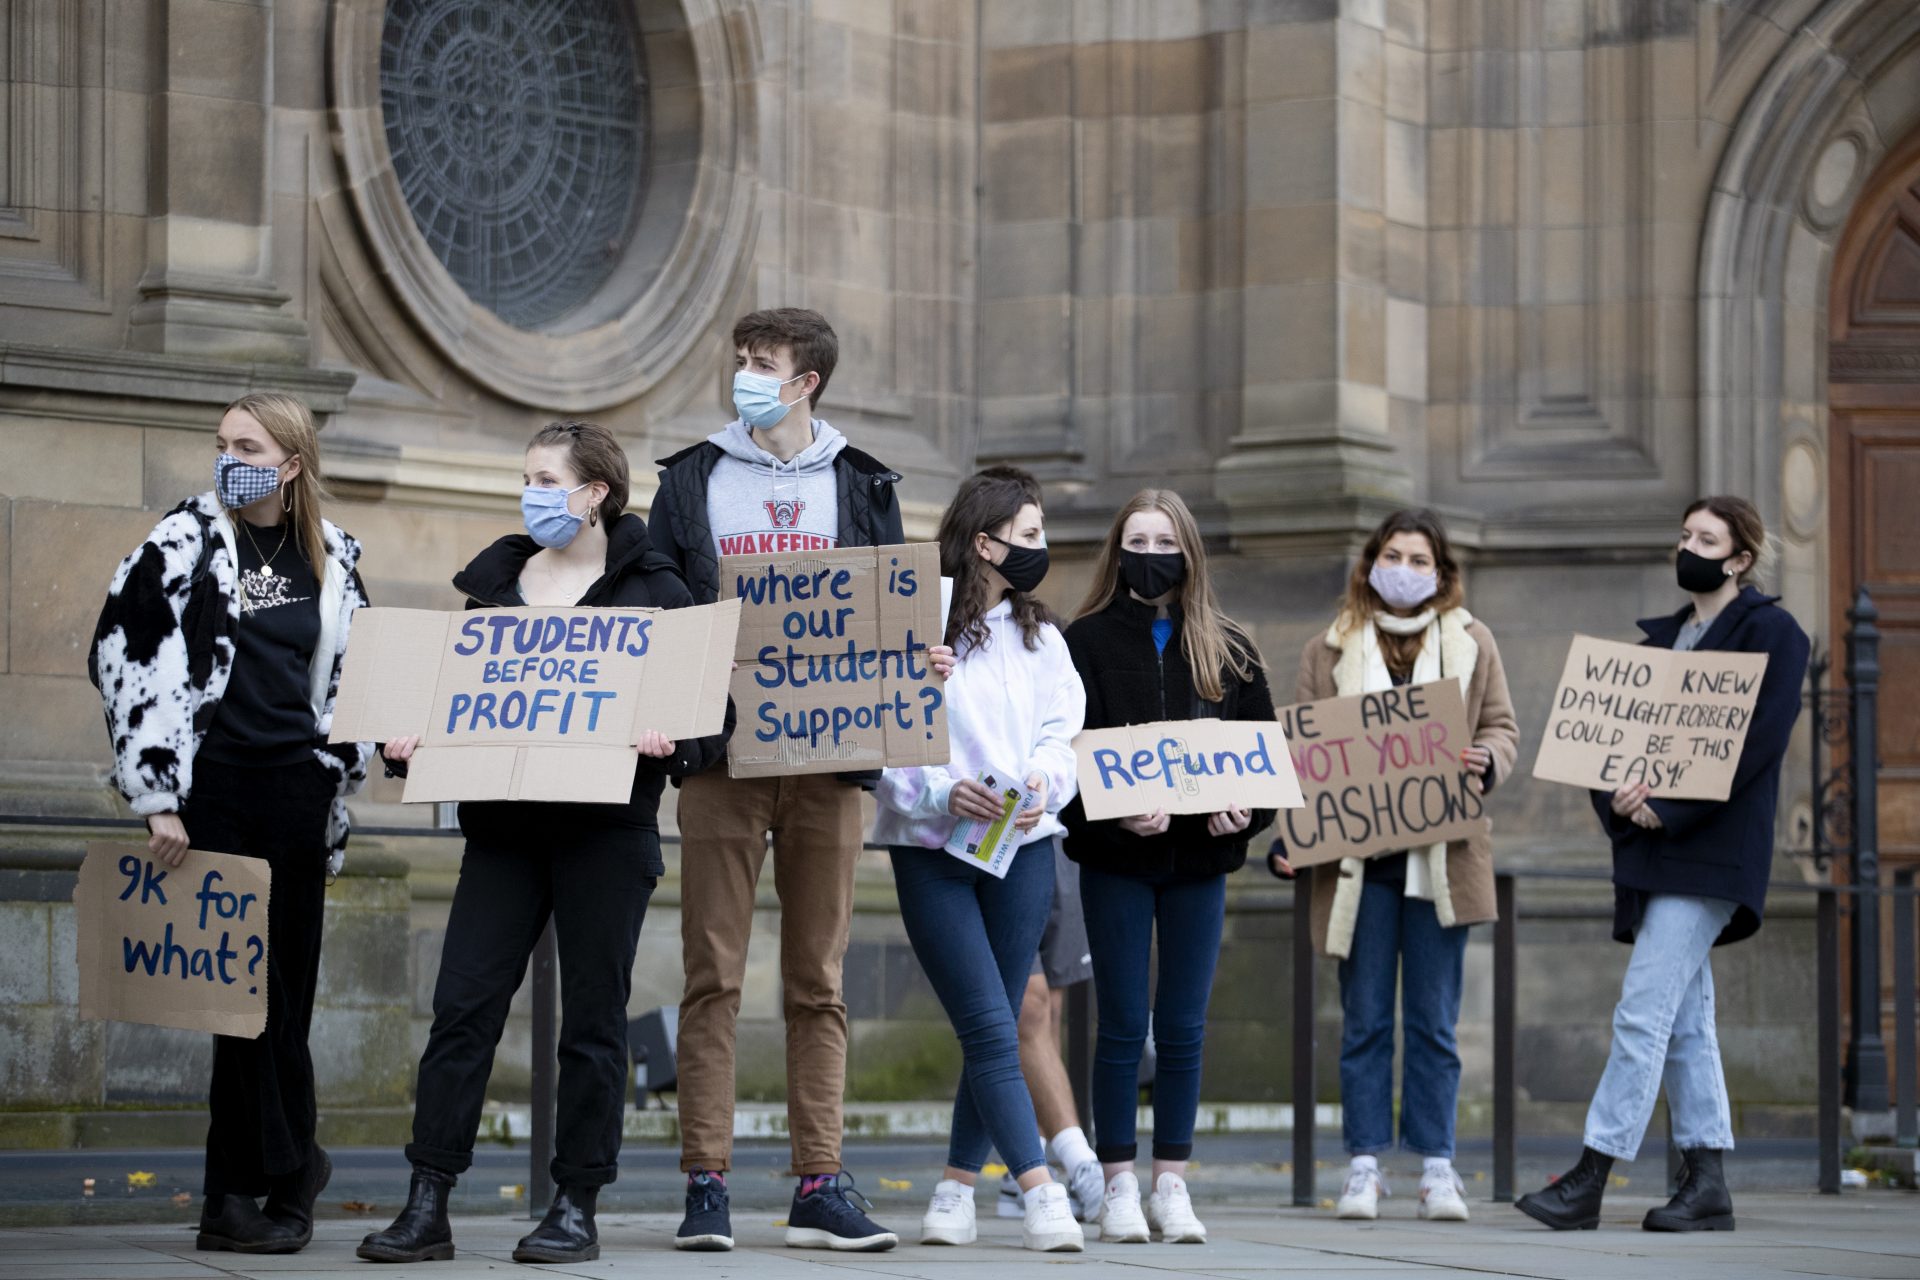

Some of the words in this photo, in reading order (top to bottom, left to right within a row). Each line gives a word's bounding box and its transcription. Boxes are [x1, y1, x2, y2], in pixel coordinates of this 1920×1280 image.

[737, 564, 853, 605] where
[889, 557, 918, 597] is
[454, 615, 653, 657] STUDENTS
[783, 607, 855, 640] our
[482, 657, 599, 684] BEFORE
[1585, 653, 1652, 688] WHO
[1681, 669, 1758, 695] KNEW
[446, 689, 618, 735] PROFIT
[1360, 687, 1429, 729] ARE
[1093, 731, 1277, 790] Refund
[1366, 721, 1458, 776] YOUR
[1555, 720, 1625, 746] COULD
[1646, 734, 1674, 756] BE
[1689, 736, 1735, 761] THIS
[1600, 753, 1693, 789] EASY?
[196, 870, 257, 930] for
[123, 922, 265, 995] what?
